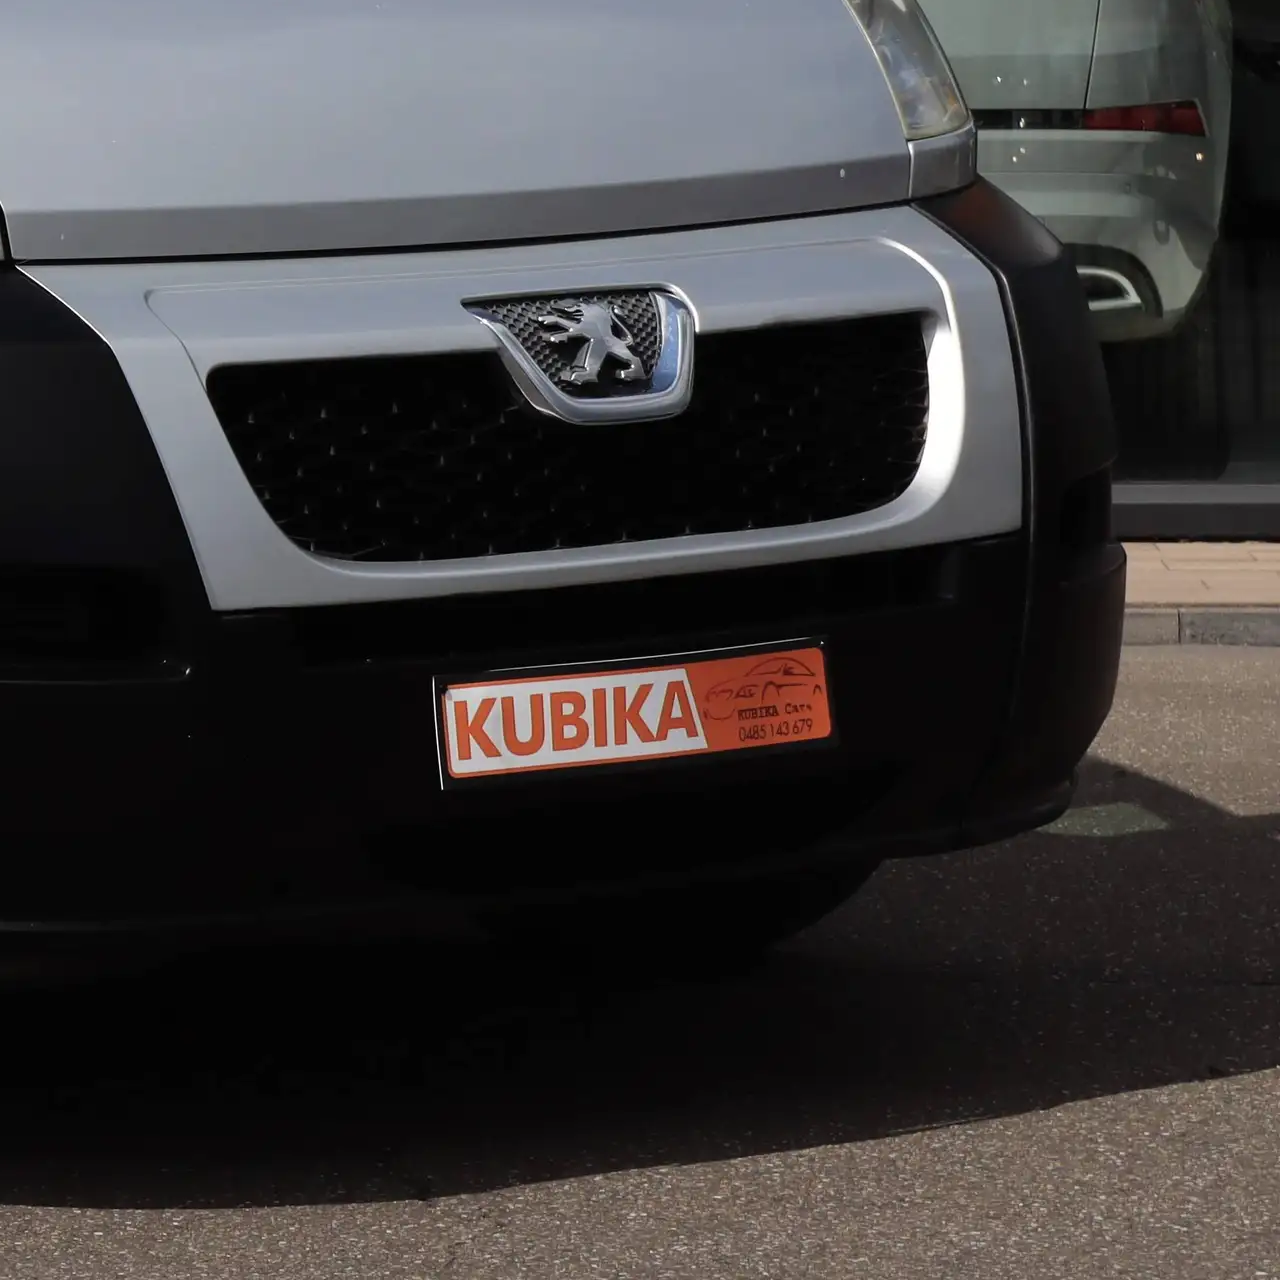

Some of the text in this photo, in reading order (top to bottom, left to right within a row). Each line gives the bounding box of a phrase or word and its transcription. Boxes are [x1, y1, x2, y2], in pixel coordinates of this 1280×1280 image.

[453, 680, 699, 761] KUBIKA
[738, 705, 779, 720] KUBIKA
[738, 718, 814, 741] 0485 143 679
